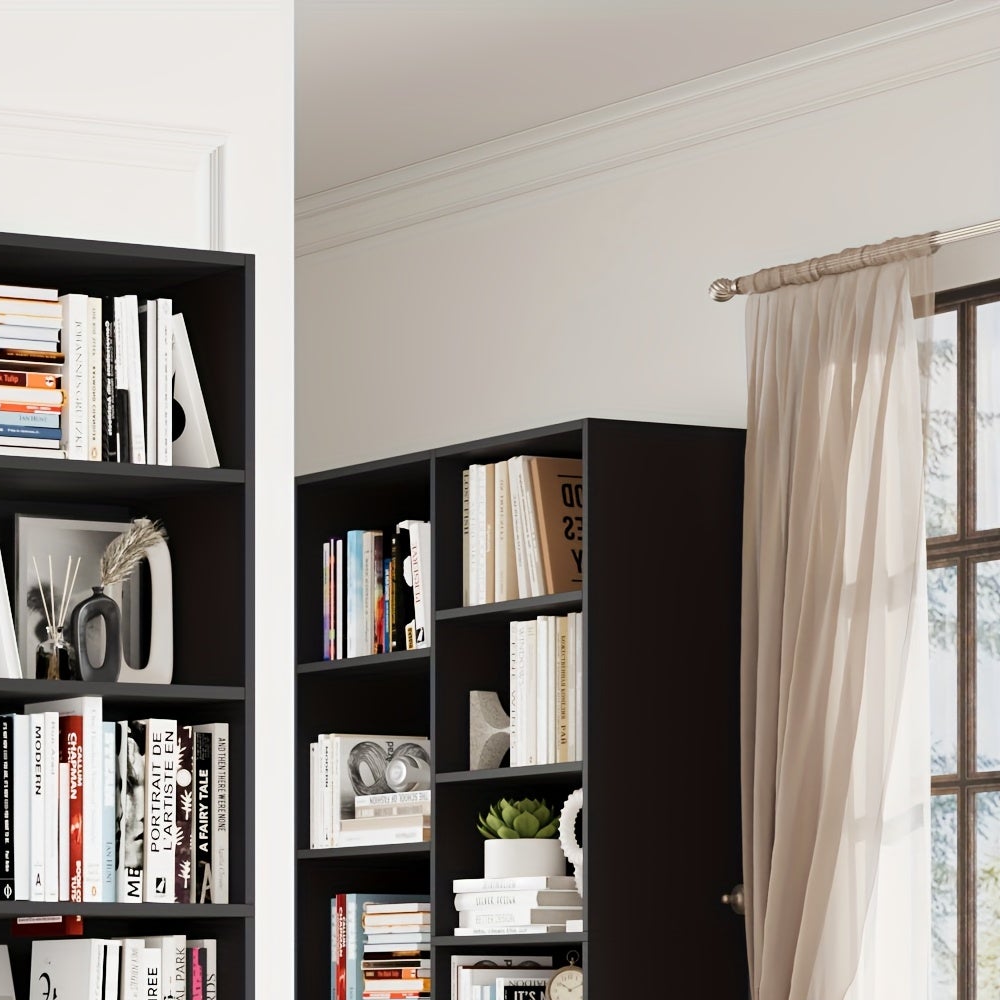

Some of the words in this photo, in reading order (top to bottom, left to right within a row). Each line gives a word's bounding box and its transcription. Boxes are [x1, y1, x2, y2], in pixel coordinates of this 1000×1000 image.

[2, 374, 19, 384] Tulip
[153, 732, 162, 756] DE
[165, 731, 174, 753] EN
[218, 737, 226, 751] AND
[70, 732, 78, 799] CHAPMAN
[218, 753, 226, 770] THEN
[199, 769, 209, 803] TALE
[218, 772, 226, 792] THERE
[151, 764, 160, 853] PORTRAIT
[163, 760, 174, 851] L'ARTISTE
[218, 794, 226, 813] WERE
[199, 807, 209, 841] FAIRY
[217, 814, 225, 832] NONE
[199, 843, 209, 852] A
[175, 947, 186, 981] PARK
